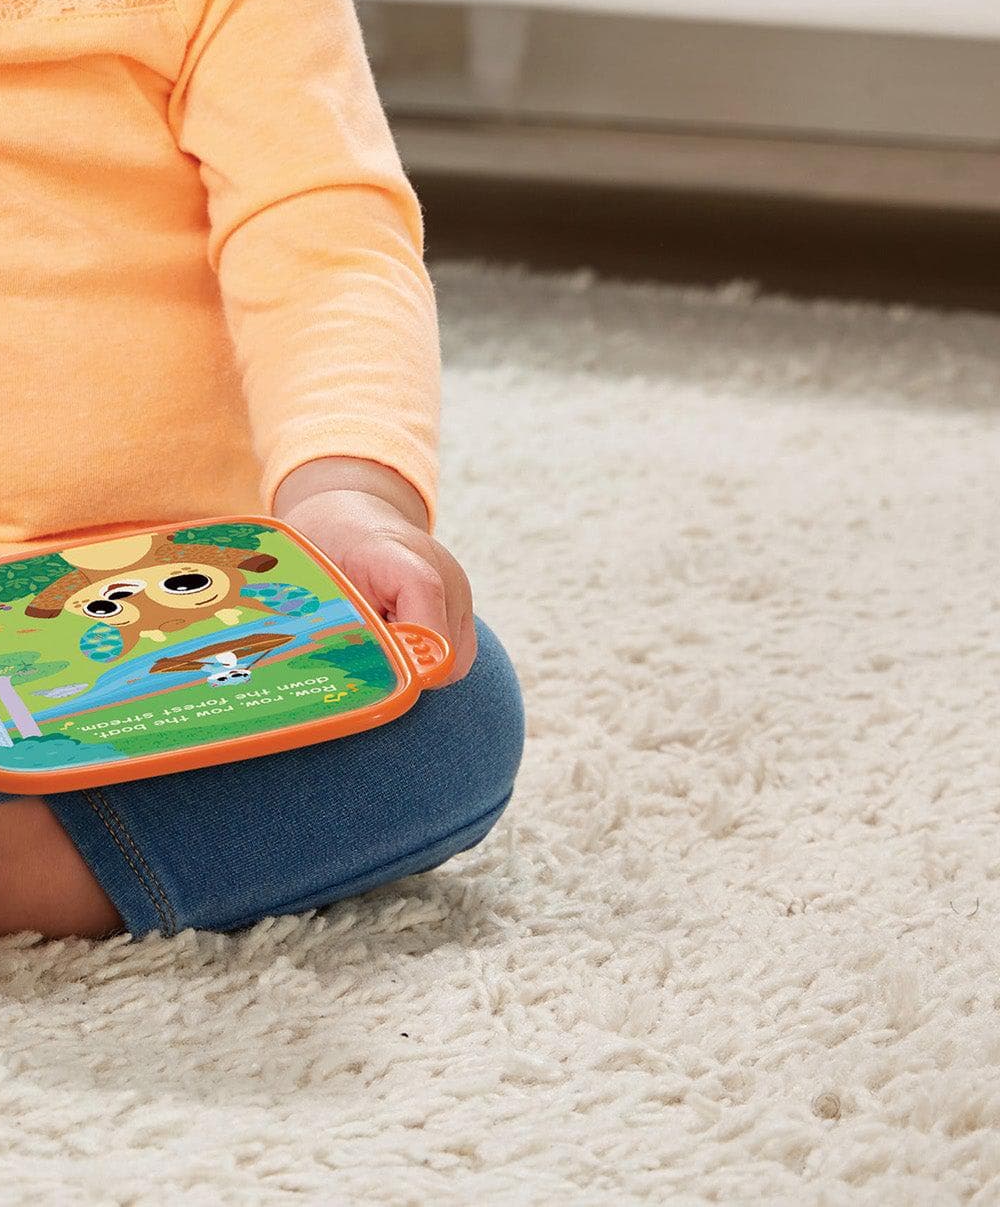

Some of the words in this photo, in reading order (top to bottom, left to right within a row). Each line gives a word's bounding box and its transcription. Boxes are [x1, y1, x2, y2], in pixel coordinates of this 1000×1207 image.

[276, 676, 330, 692] down
[235, 688, 271, 701] the
[162, 697, 229, 717] forest
[196, 705, 234, 718] row
[76, 712, 154, 732] stream.
[153, 715, 189, 727] the
